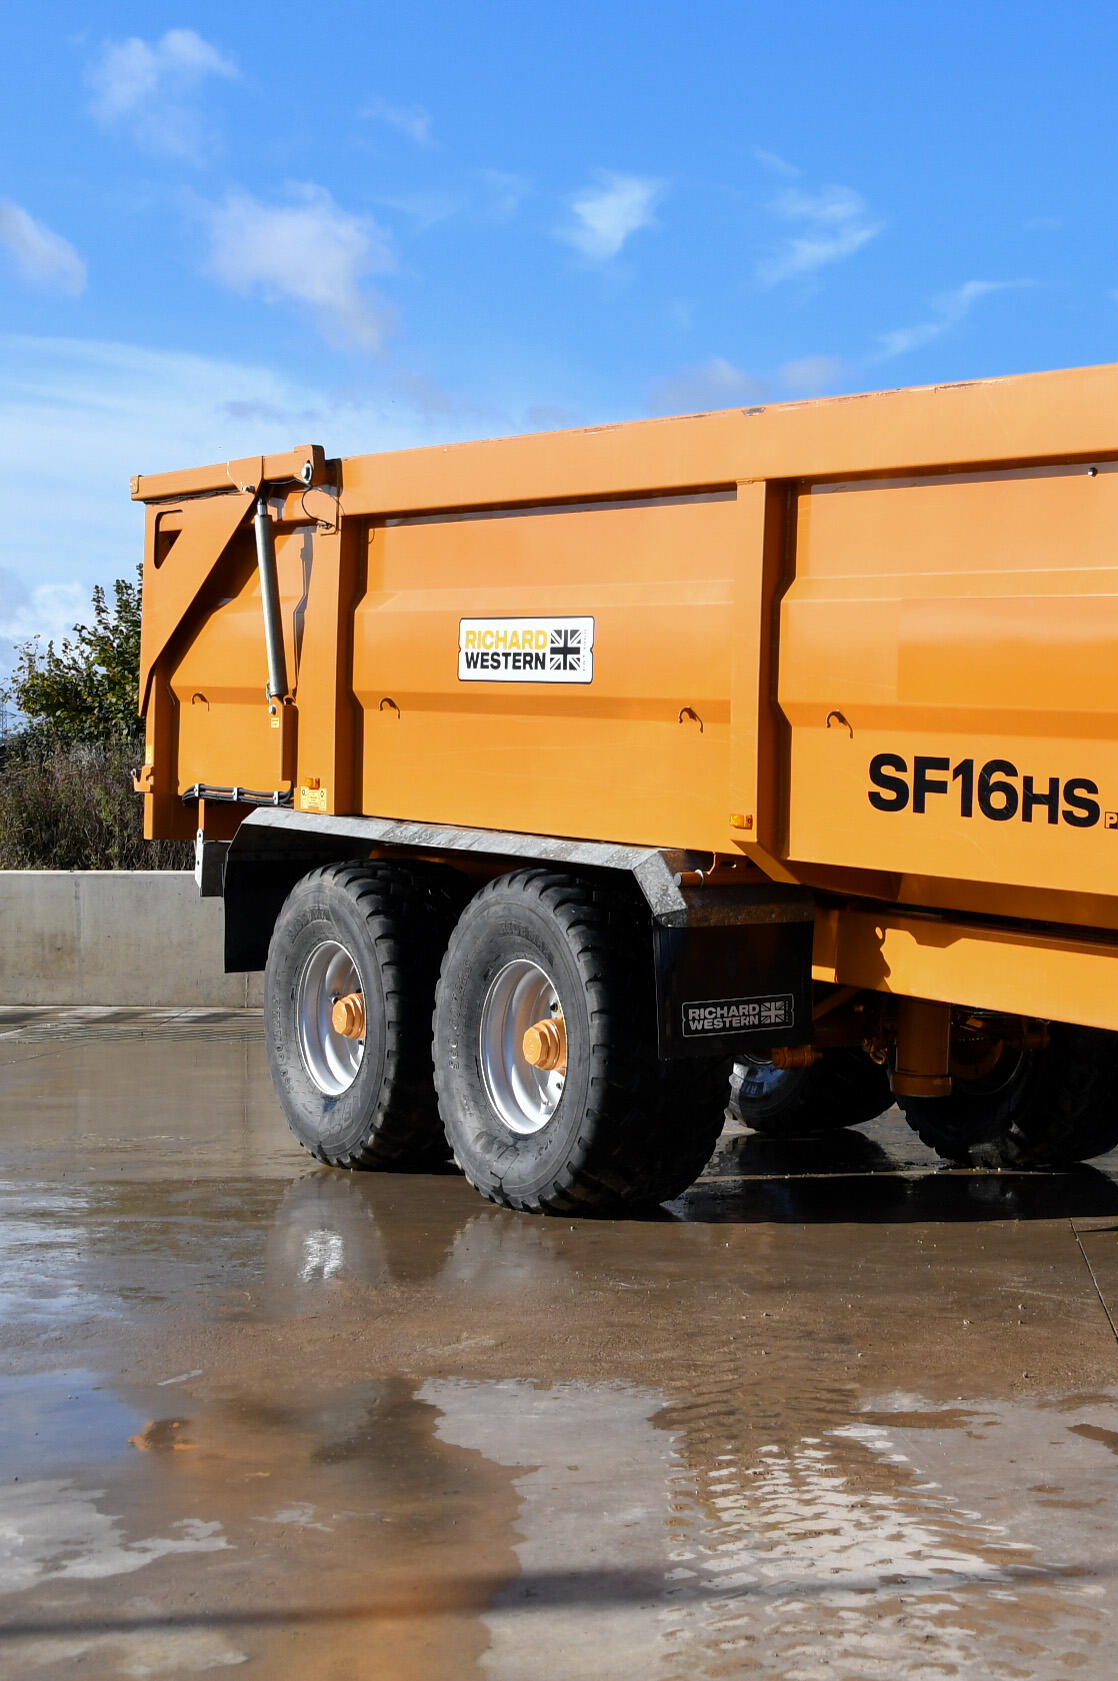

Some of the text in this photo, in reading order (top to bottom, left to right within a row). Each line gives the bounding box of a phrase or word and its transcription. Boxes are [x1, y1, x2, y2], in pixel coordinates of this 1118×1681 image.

[465, 629, 548, 650] RICHARD
[465, 651, 546, 670] WESTERN
[868, 753, 1101, 828] SF16HS
[688, 1004, 759, 1019] RICHARD
[689, 1015, 759, 1030] WESTERN
